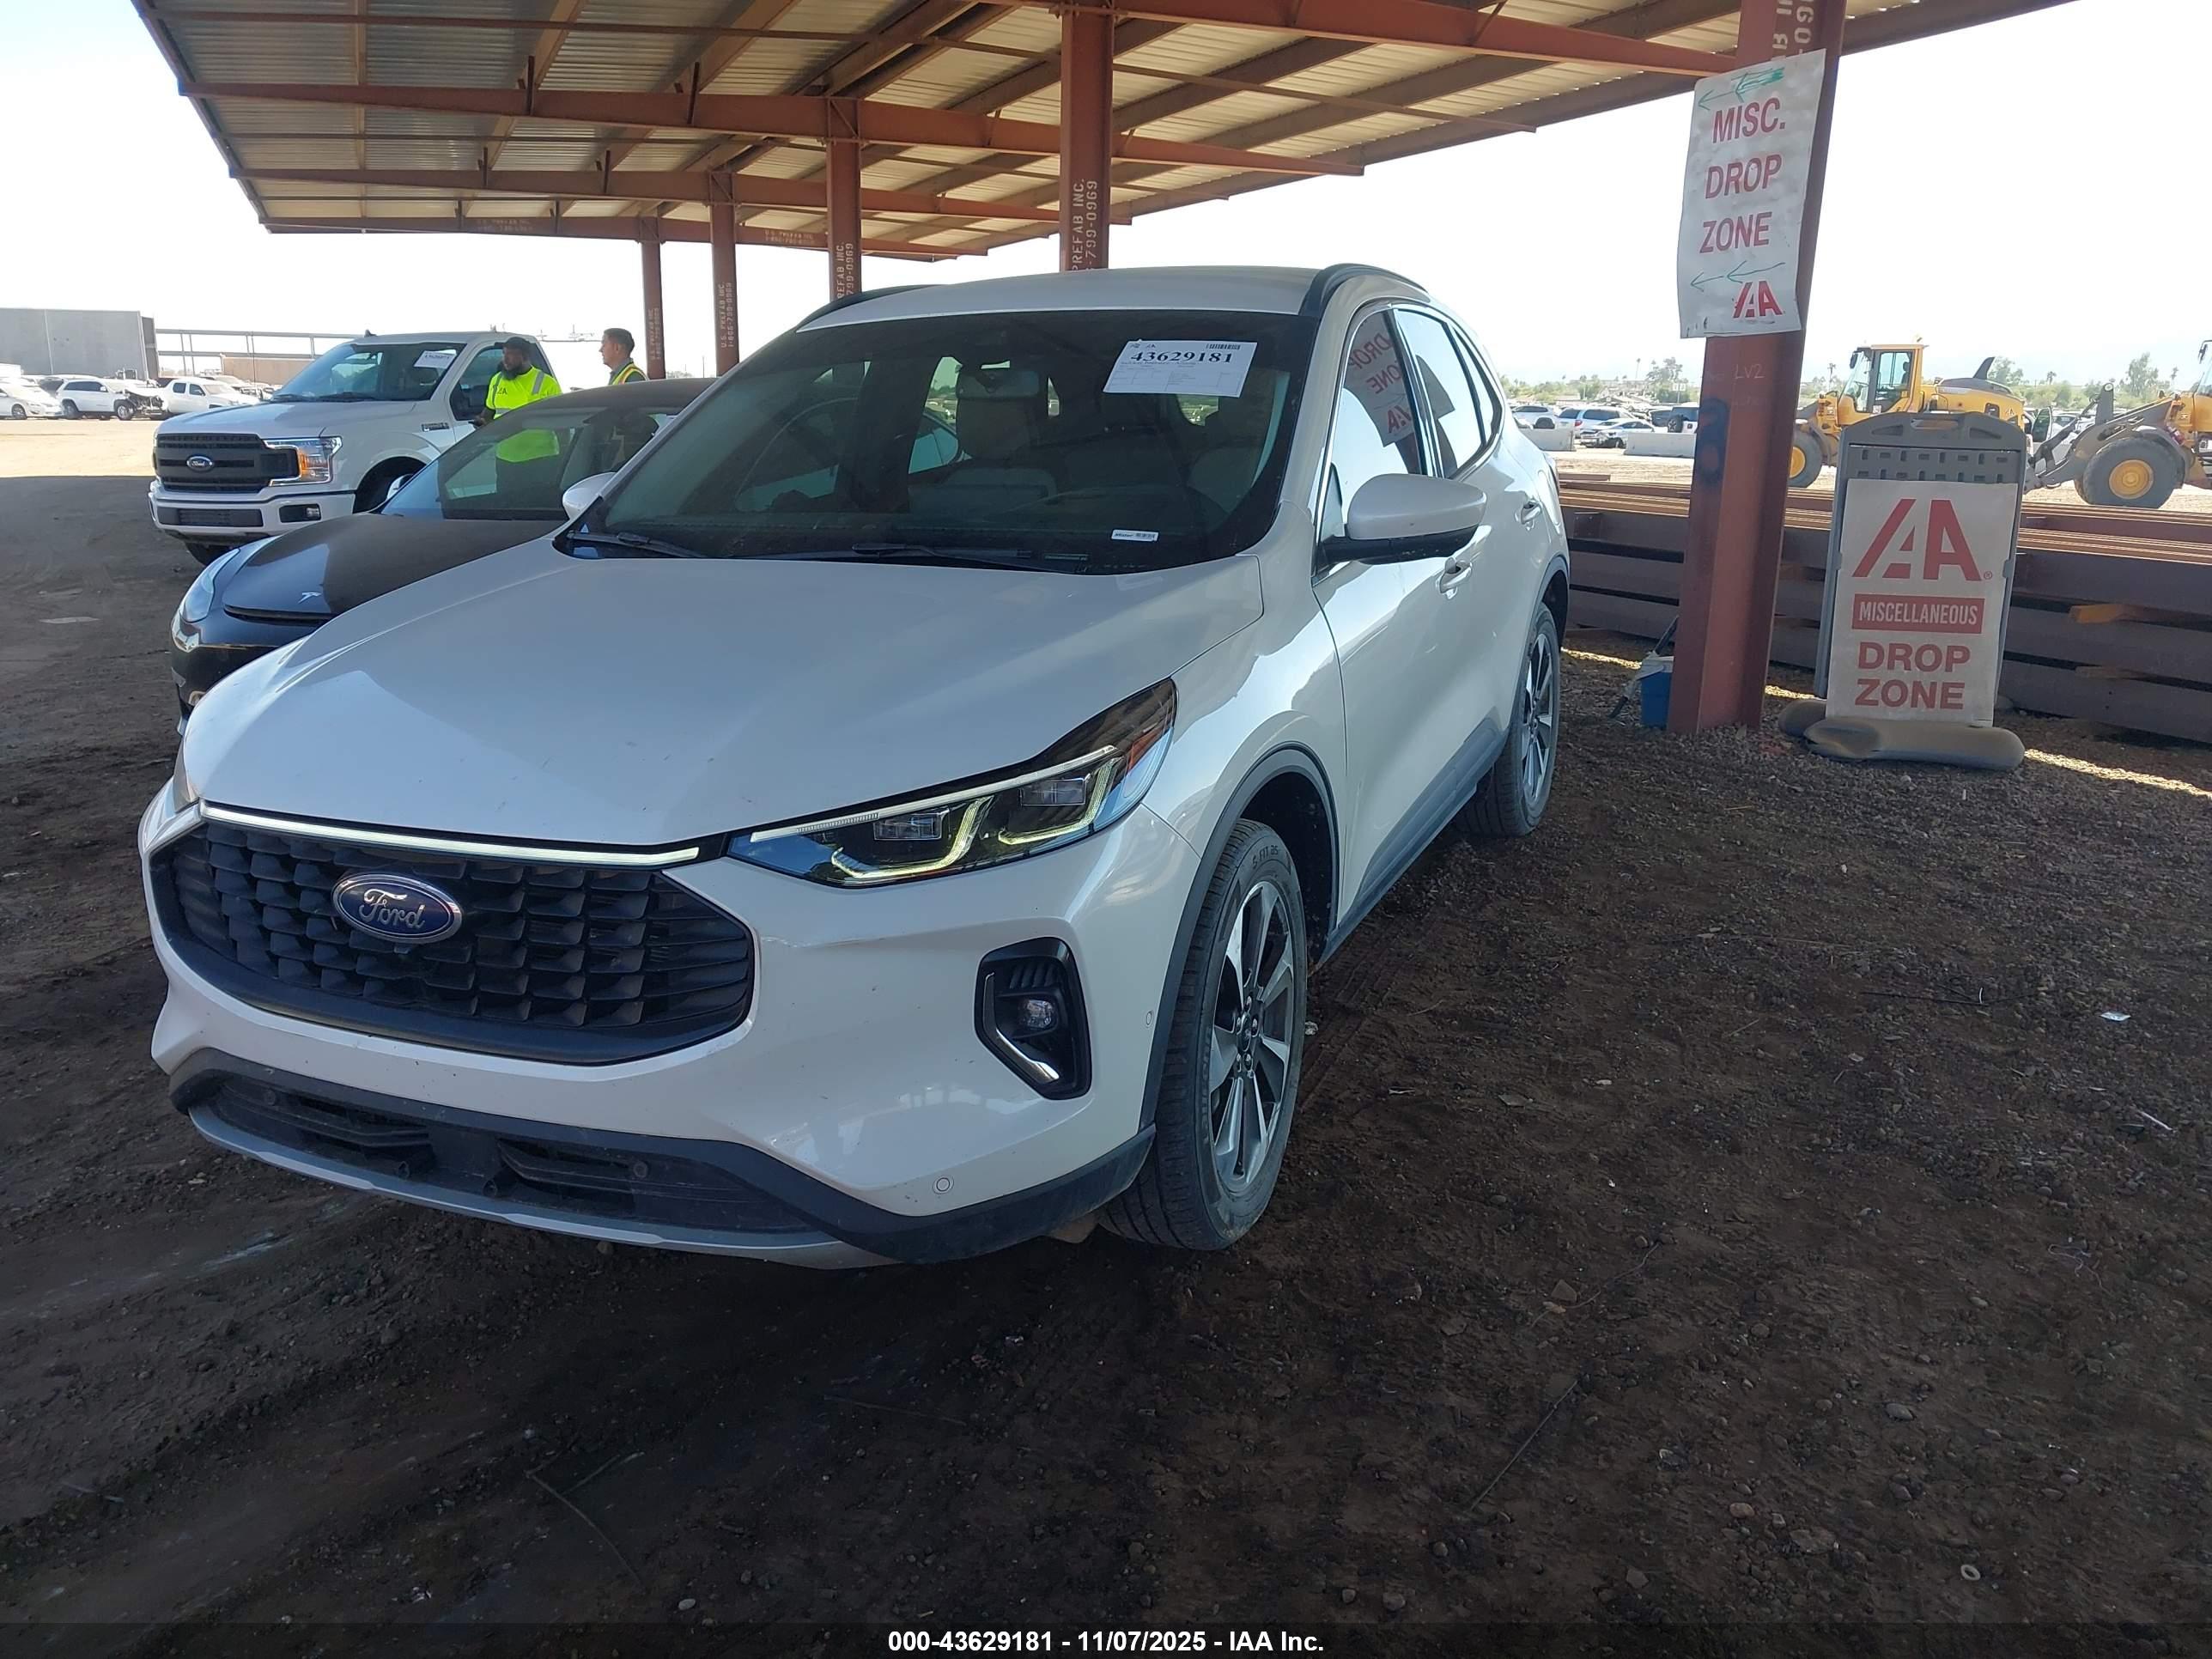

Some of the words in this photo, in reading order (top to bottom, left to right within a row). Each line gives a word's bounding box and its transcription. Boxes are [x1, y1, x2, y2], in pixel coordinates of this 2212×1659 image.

[1712, 96, 1786, 143] MISC.
[1073, 179, 1085, 207] INC.
[1705, 154, 1782, 199] DROP
[1085, 180, 1097, 270] -799-0969
[1699, 211, 1773, 253] ZONE
[1130, 351, 1233, 363] 43629181
[1858, 601, 1978, 626] MISCELLANEOUS
[1857, 641, 1971, 672] DROP
[1854, 678, 1966, 709] ZONE
[358, 888, 426, 929] Ford
